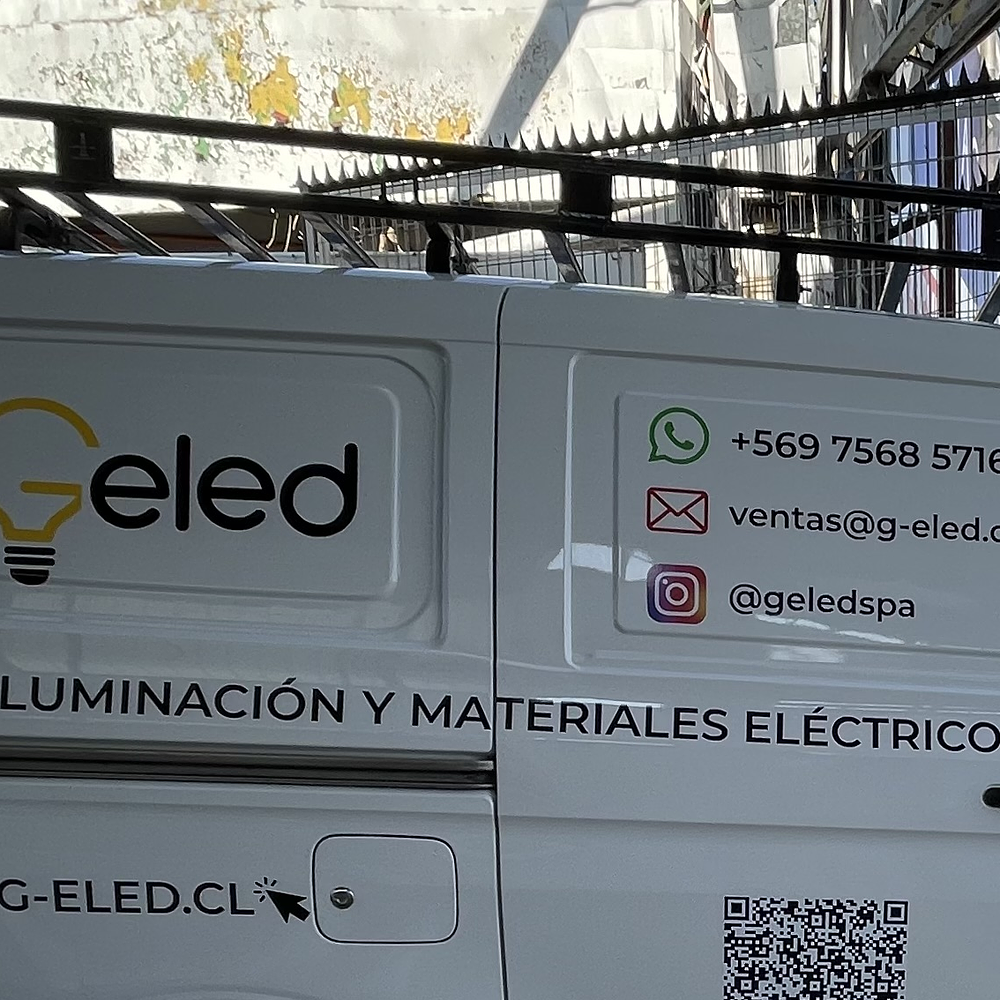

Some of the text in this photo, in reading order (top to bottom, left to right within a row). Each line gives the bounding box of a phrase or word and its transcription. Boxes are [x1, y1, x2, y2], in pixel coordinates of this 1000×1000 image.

[731, 429, 821, 460] +569
[831, 435, 921, 468] 7568
[729, 583, 916, 622] @geledspa
[362, 690, 396, 726] Y
[411, 692, 729, 742] MATERIALES
[0, 878, 256, 916] G-ELED.CL
